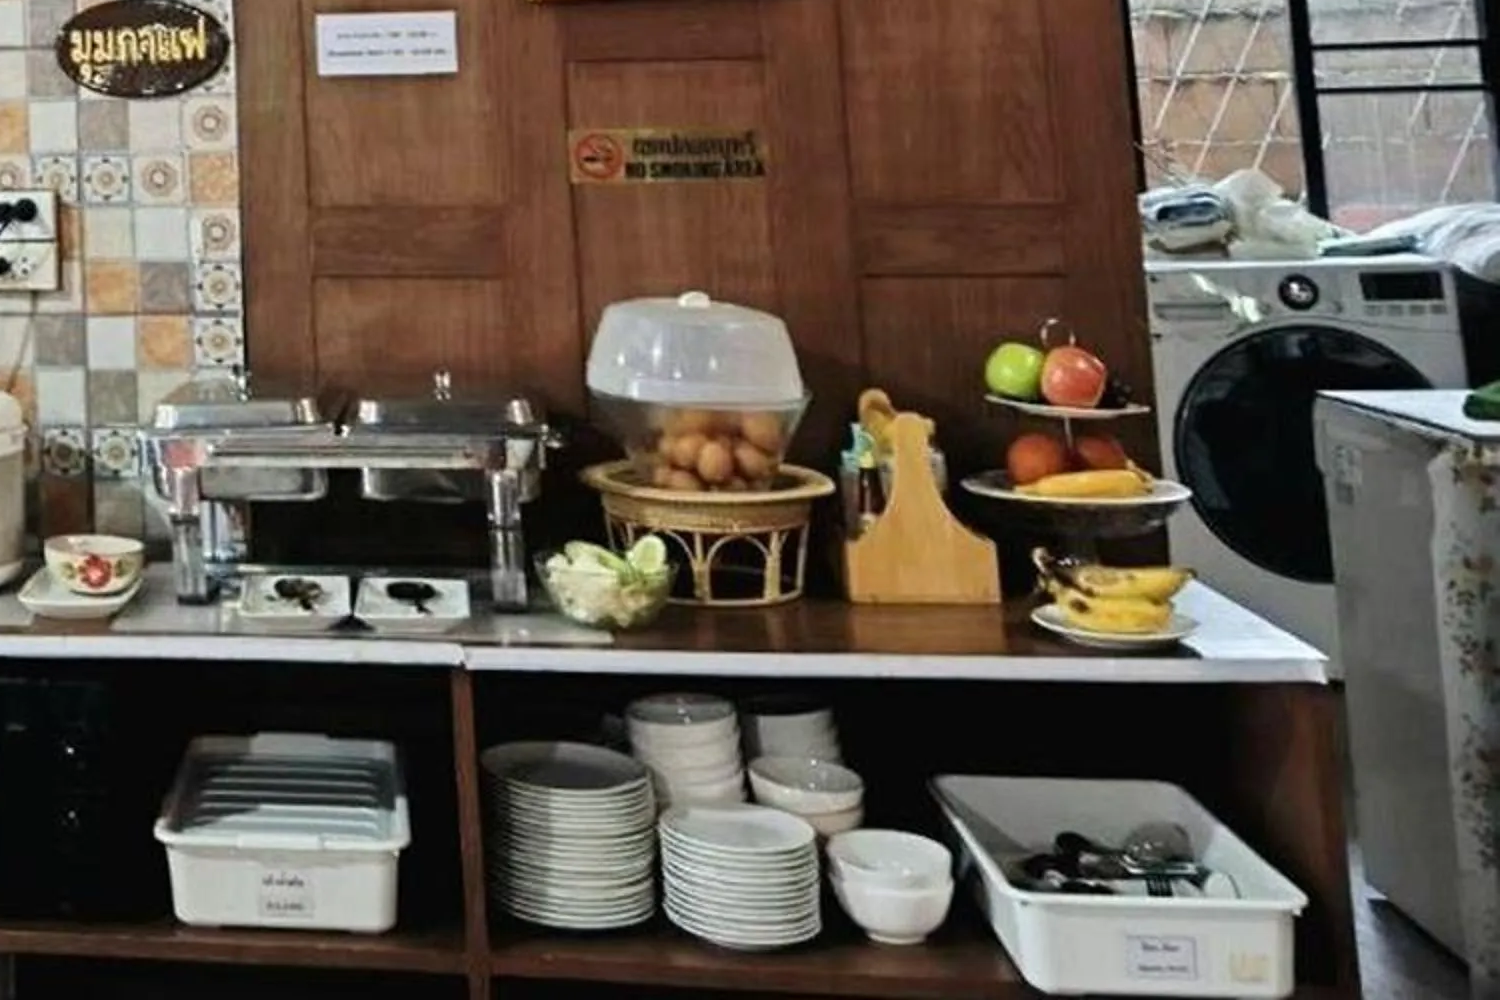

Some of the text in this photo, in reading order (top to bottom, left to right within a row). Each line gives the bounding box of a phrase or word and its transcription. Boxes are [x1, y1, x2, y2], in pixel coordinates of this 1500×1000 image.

[70, 15, 207, 83] มุมกาแฟ
[625, 160, 766, 179] NO SMOKING AREA
